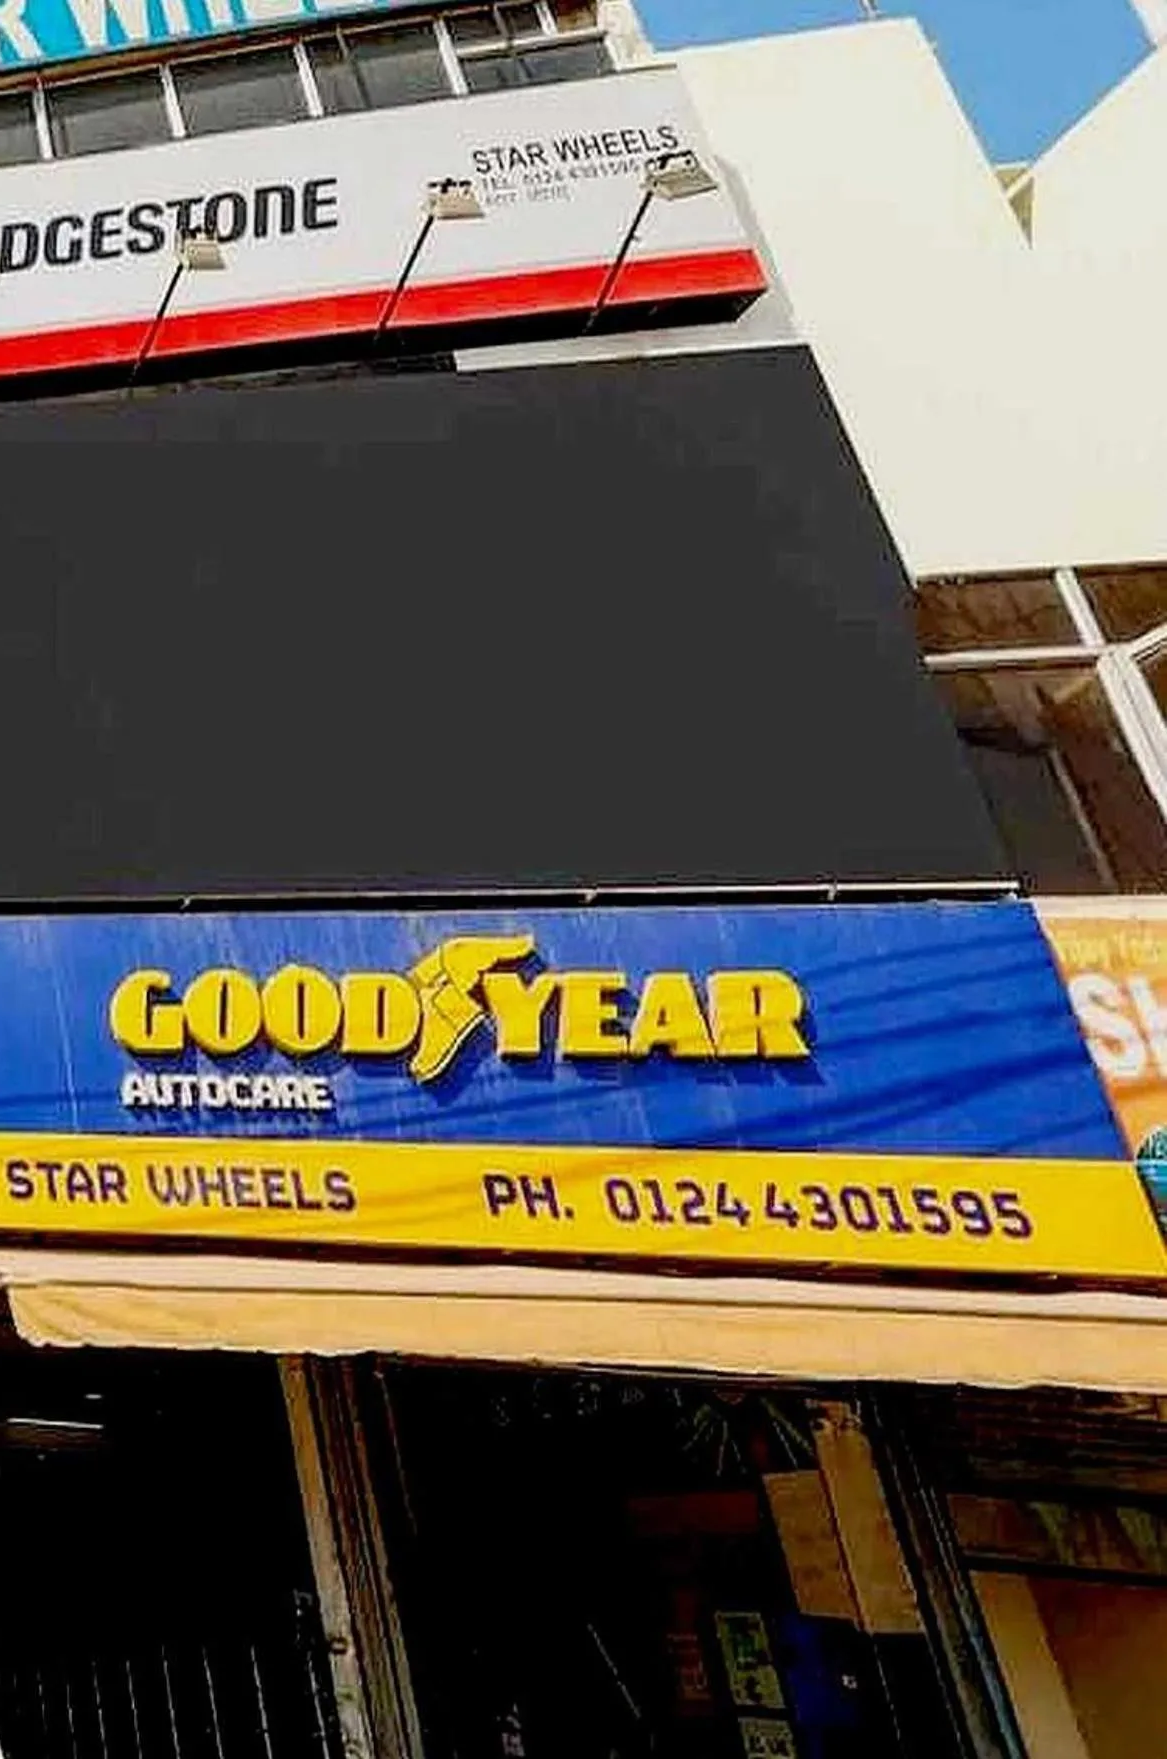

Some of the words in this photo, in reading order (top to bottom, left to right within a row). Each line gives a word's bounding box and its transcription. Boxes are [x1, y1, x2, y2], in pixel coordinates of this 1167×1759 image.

[473, 142, 549, 175] STAR
[552, 126, 679, 162] WHEELS
[120, 1073, 333, 1113] AUTOCARE
[6, 1159, 128, 1203] STAR
[147, 1165, 357, 1211] WHEELS
[482, 1174, 574, 1219] PH.
